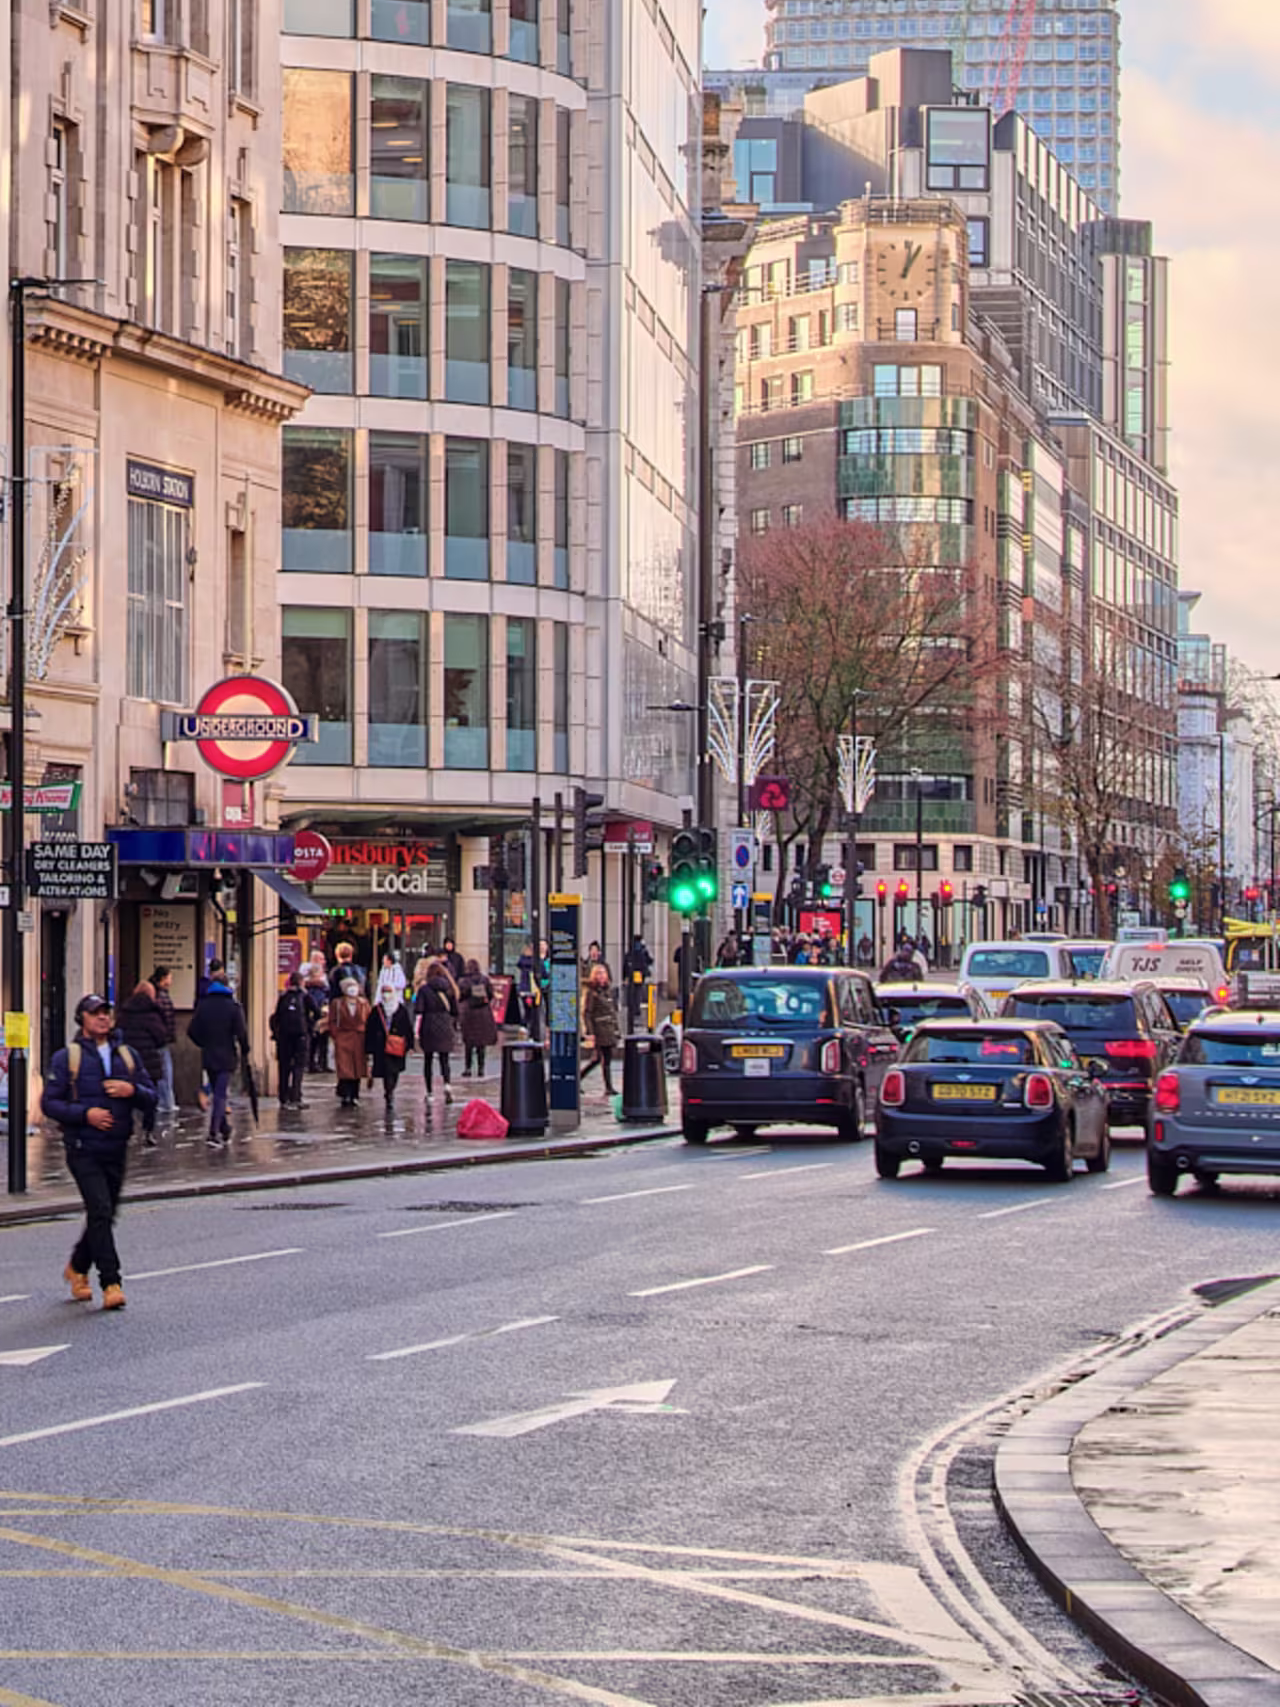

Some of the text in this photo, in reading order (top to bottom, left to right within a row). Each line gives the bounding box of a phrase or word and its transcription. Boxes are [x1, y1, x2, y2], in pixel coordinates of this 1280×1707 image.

[183, 715, 305, 737] UNDERGROUND
[33, 844, 111, 859] SAME DAY
[294, 847, 325, 858] OSTA
[33, 859, 112, 872] DRY CLEANERS
[38, 872, 106, 884] TAILORING &
[371, 867, 428, 894] Local
[37, 885, 108, 897] ALTERATIONS
